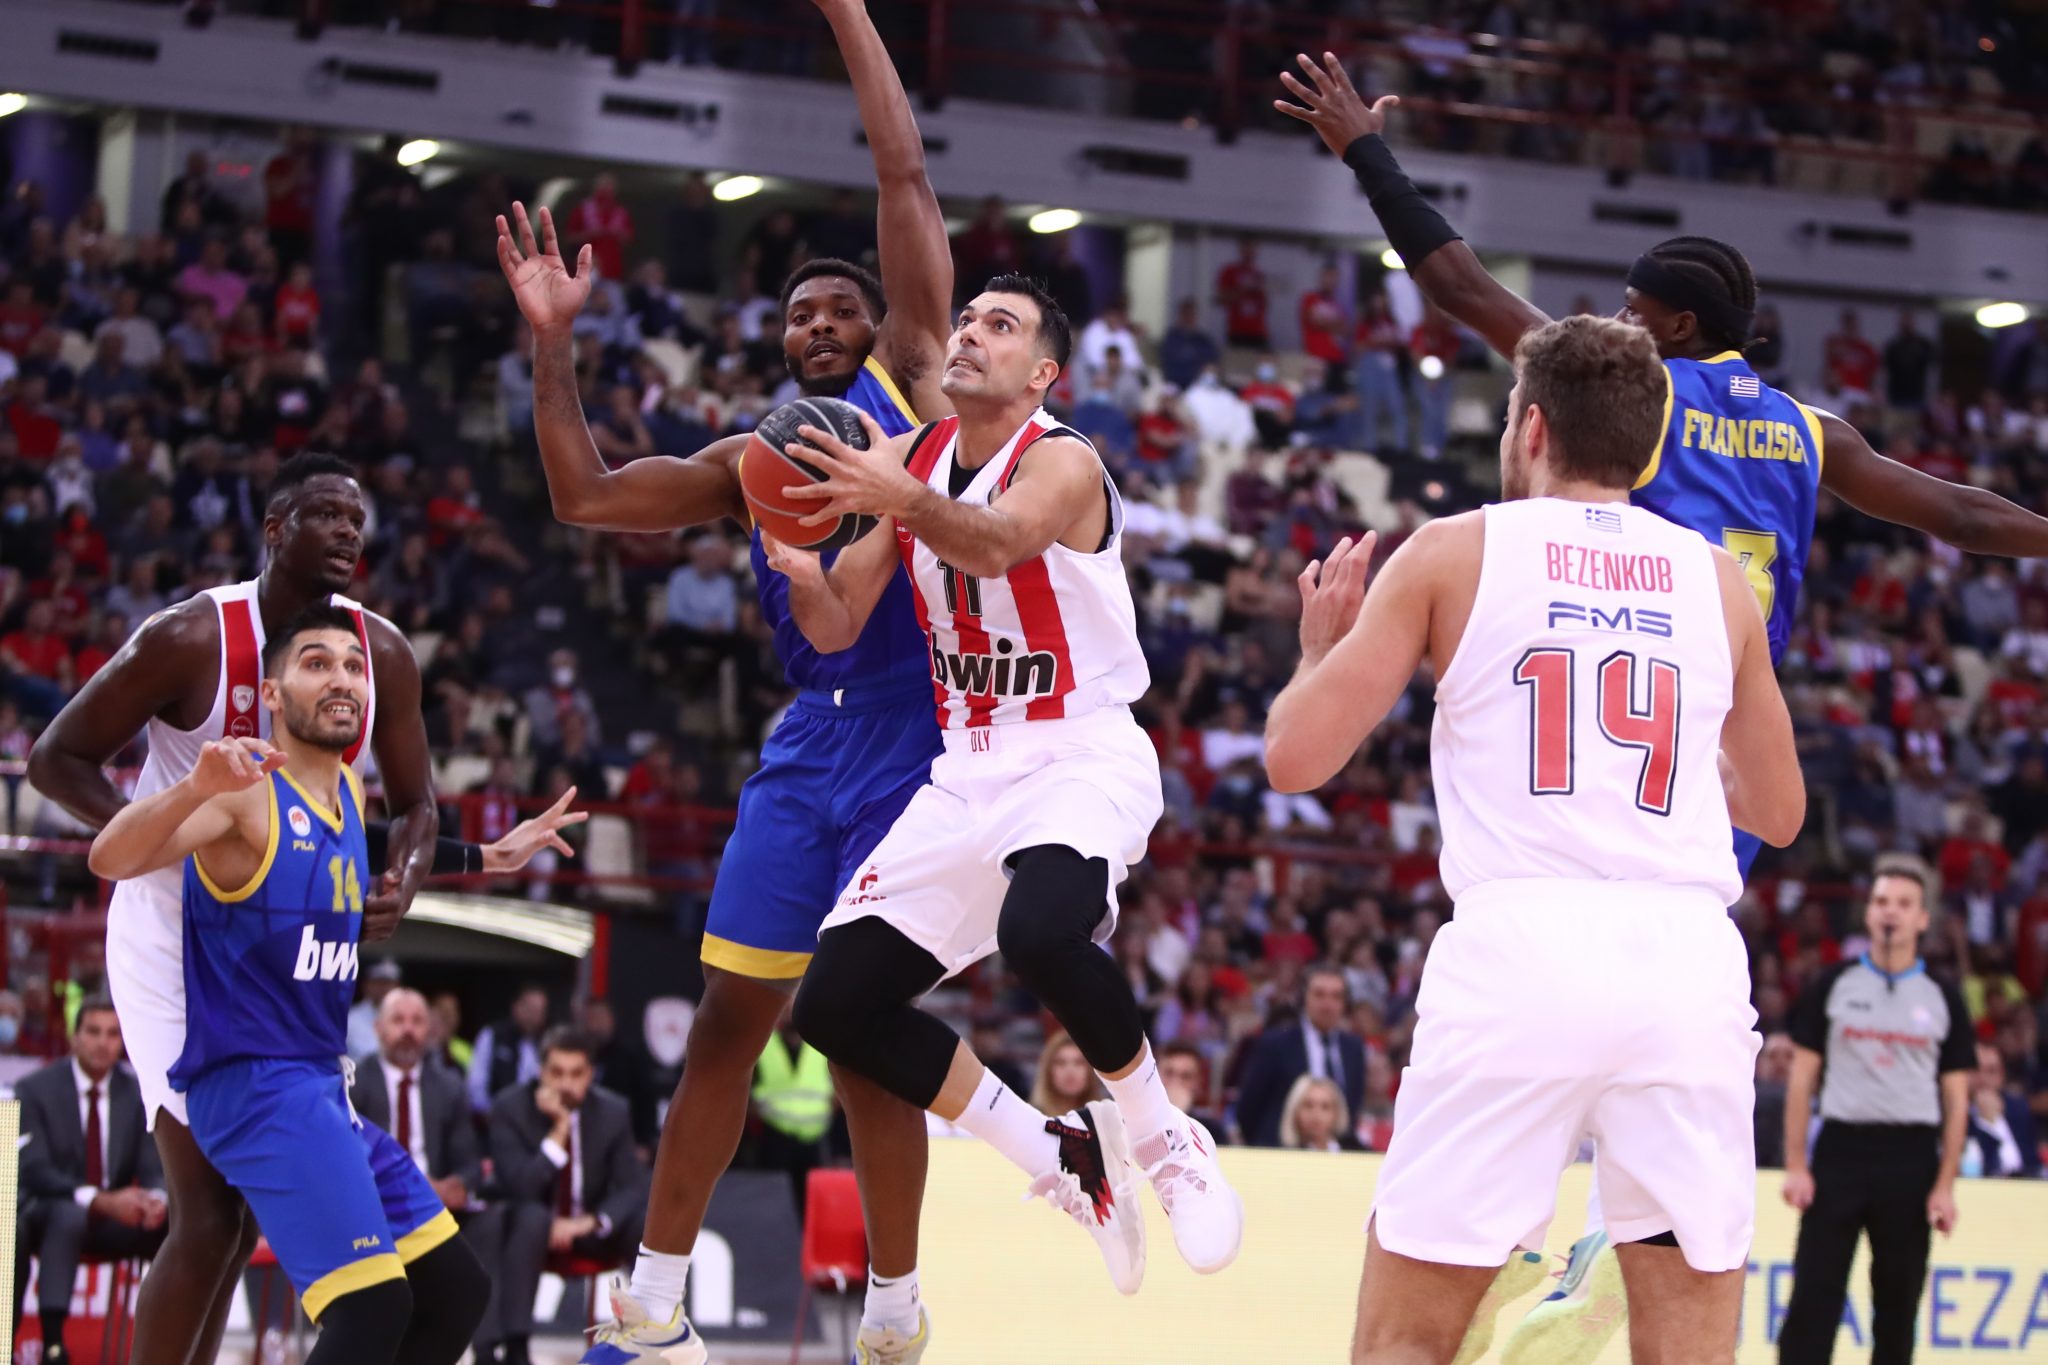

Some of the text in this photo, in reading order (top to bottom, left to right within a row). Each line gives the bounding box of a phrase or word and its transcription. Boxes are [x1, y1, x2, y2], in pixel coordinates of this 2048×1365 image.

[1682, 409, 1808, 465] FRANCISC
[937, 559, 983, 617] 11
[932, 632, 1057, 698] bwin
[971, 730, 990, 752] OLY
[1513, 647, 1681, 817] 14
[292, 839, 315, 851] FILA
[328, 855, 363, 913] 14
[352, 1234, 380, 1251] FILA
